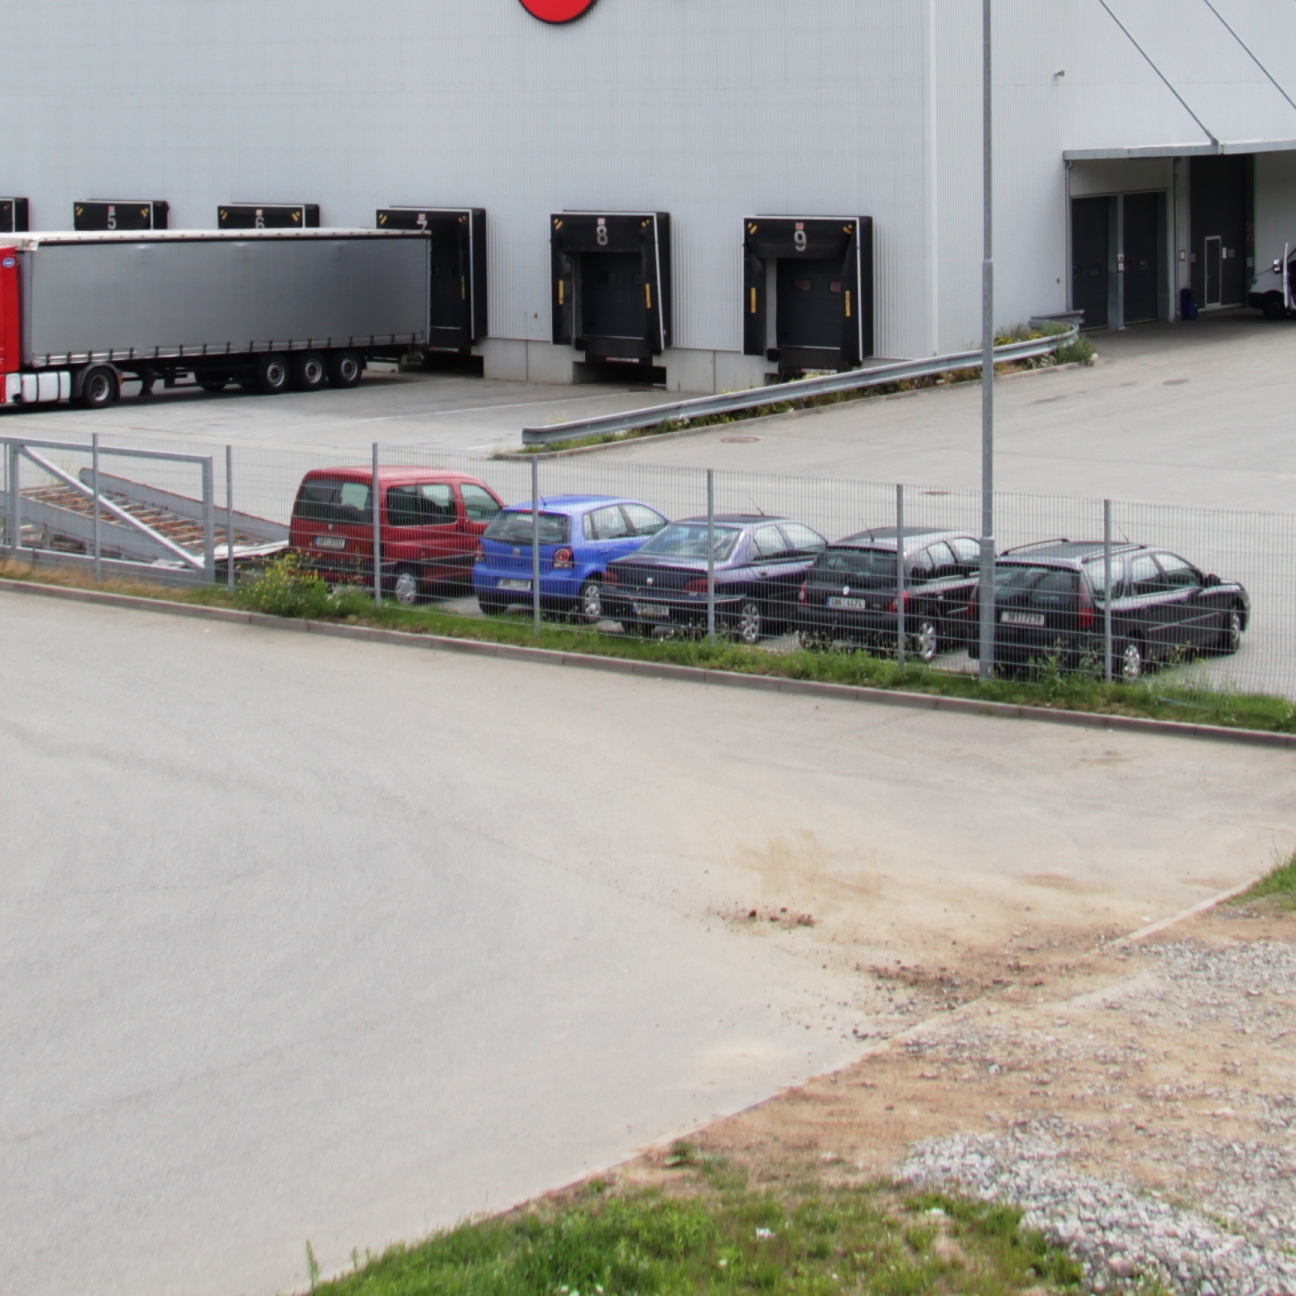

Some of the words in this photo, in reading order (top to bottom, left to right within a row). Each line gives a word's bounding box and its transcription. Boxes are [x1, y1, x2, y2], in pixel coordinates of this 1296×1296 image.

[108, 213, 116, 230] 5
[596, 225, 607, 245] 8
[794, 230, 806, 251] 9
